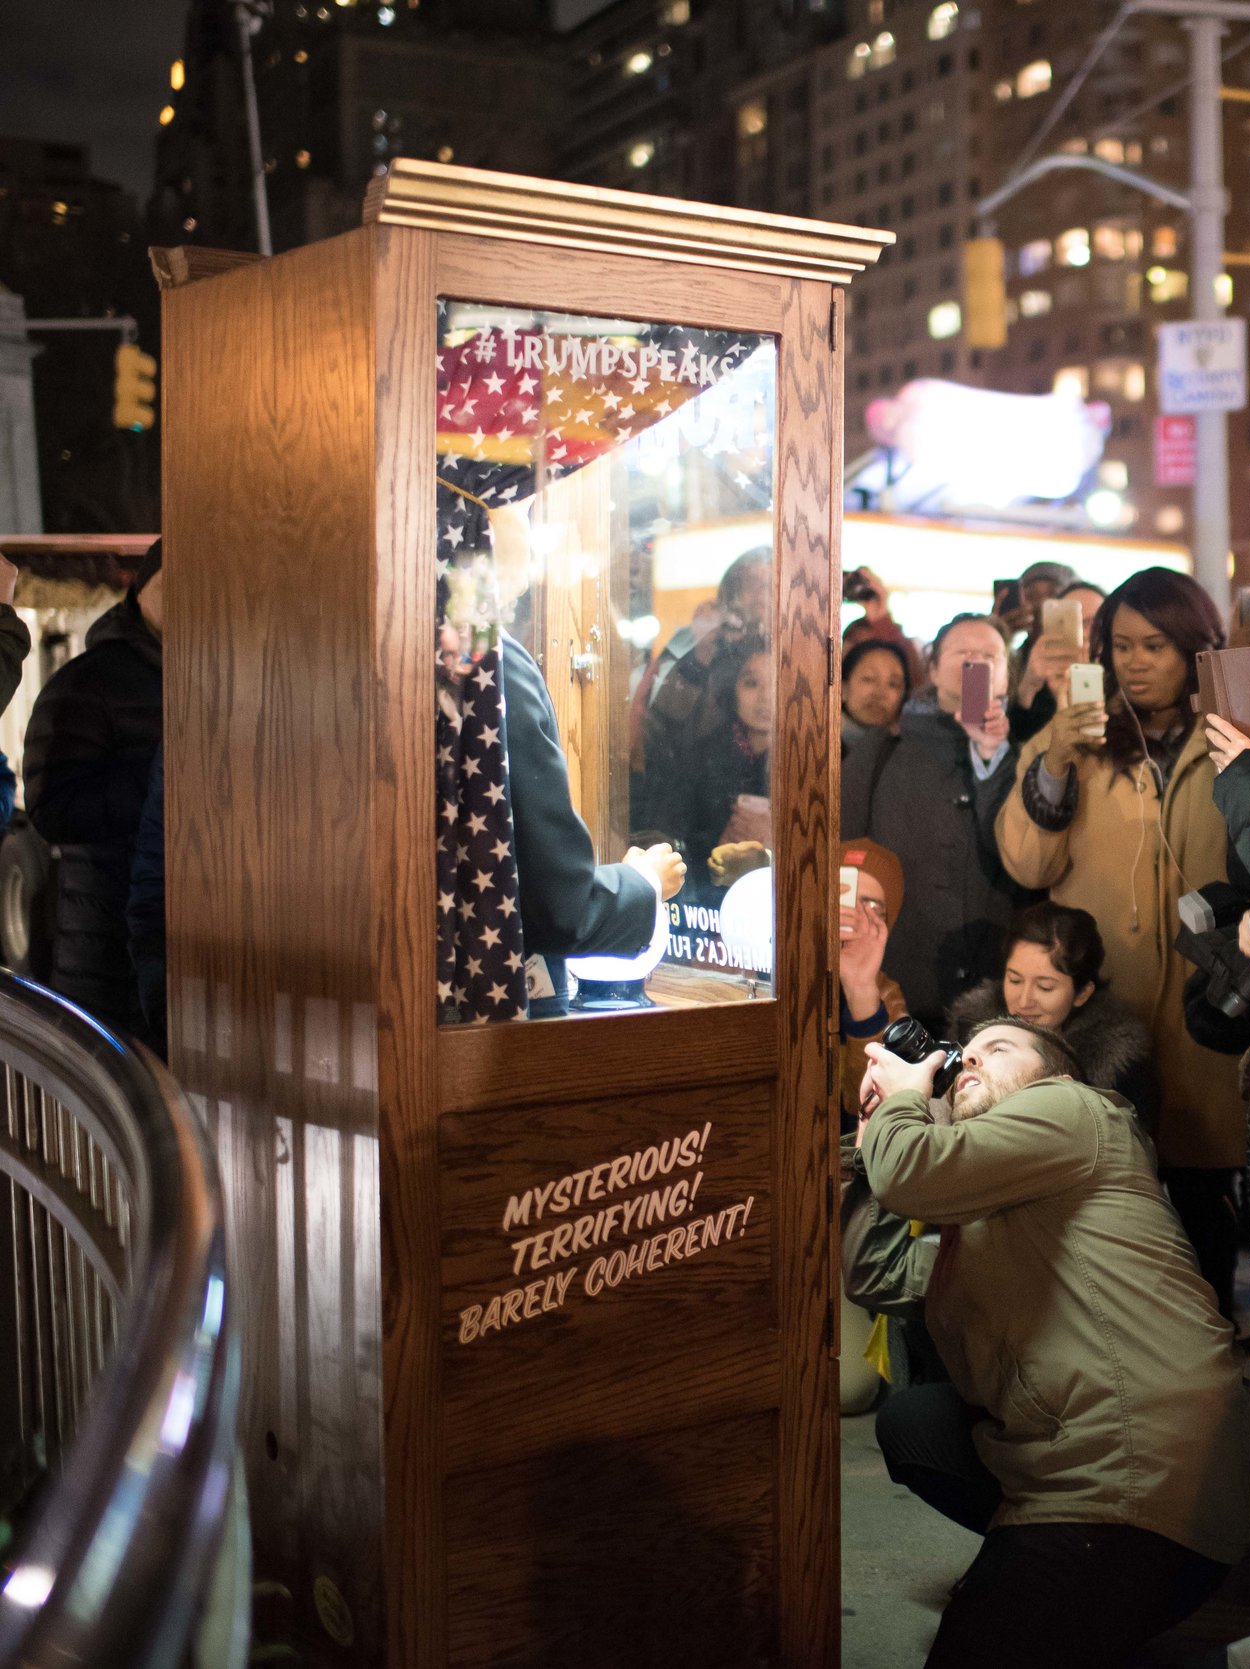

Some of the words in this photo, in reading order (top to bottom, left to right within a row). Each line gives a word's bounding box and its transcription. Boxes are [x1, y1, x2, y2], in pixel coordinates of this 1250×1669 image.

[503, 1121, 712, 1232] MYSTERIOUS!
[511, 1171, 704, 1275] TERRIFYING!
[459, 1267, 578, 1344] BARELY
[584, 1196, 755, 1296] COHERENT!
